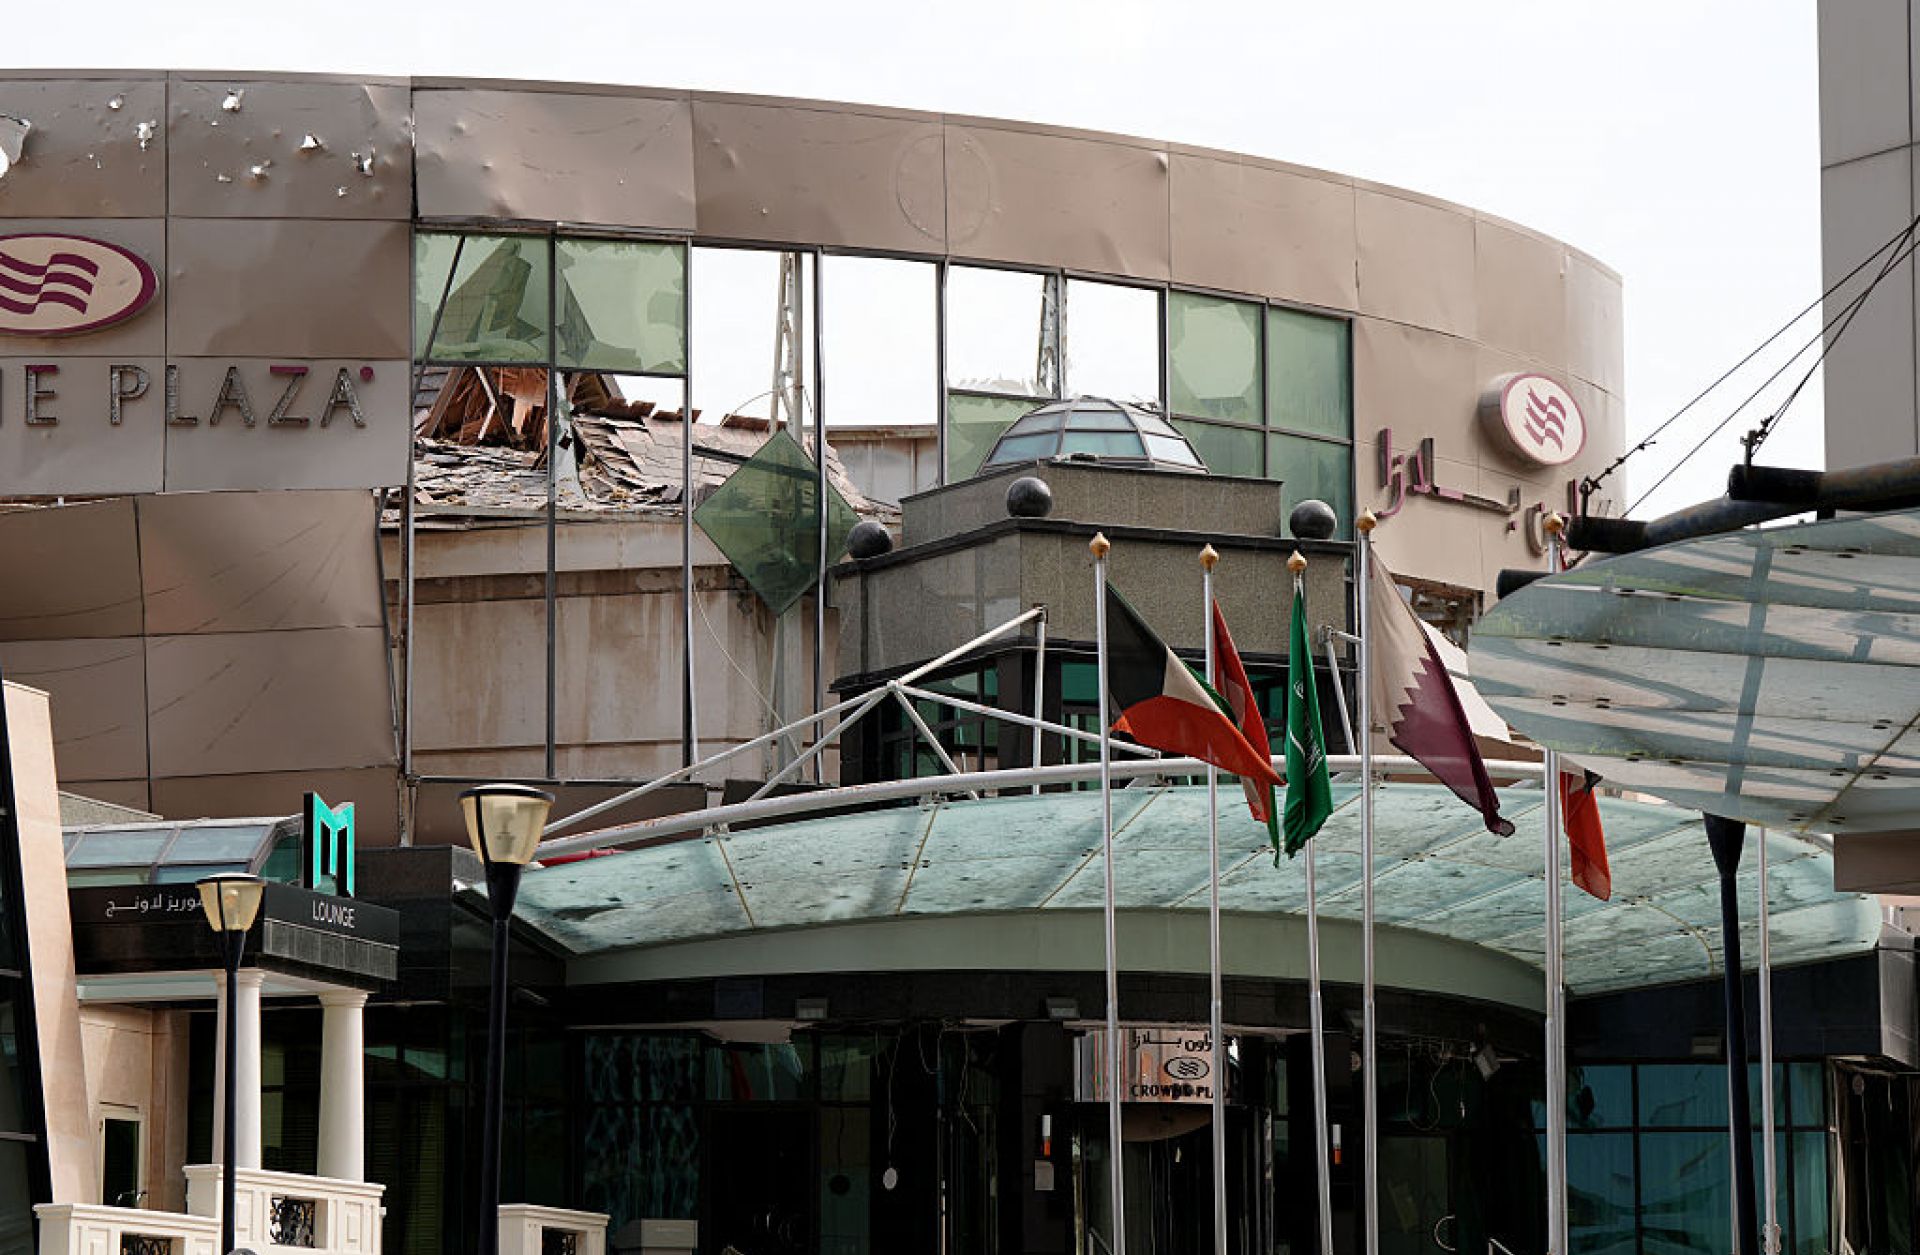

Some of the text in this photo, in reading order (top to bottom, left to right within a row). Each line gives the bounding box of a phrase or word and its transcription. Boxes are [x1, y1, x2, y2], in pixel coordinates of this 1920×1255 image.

[0, 364, 369, 427] E PLAZA
[312, 900, 355, 928] LOUNGE
